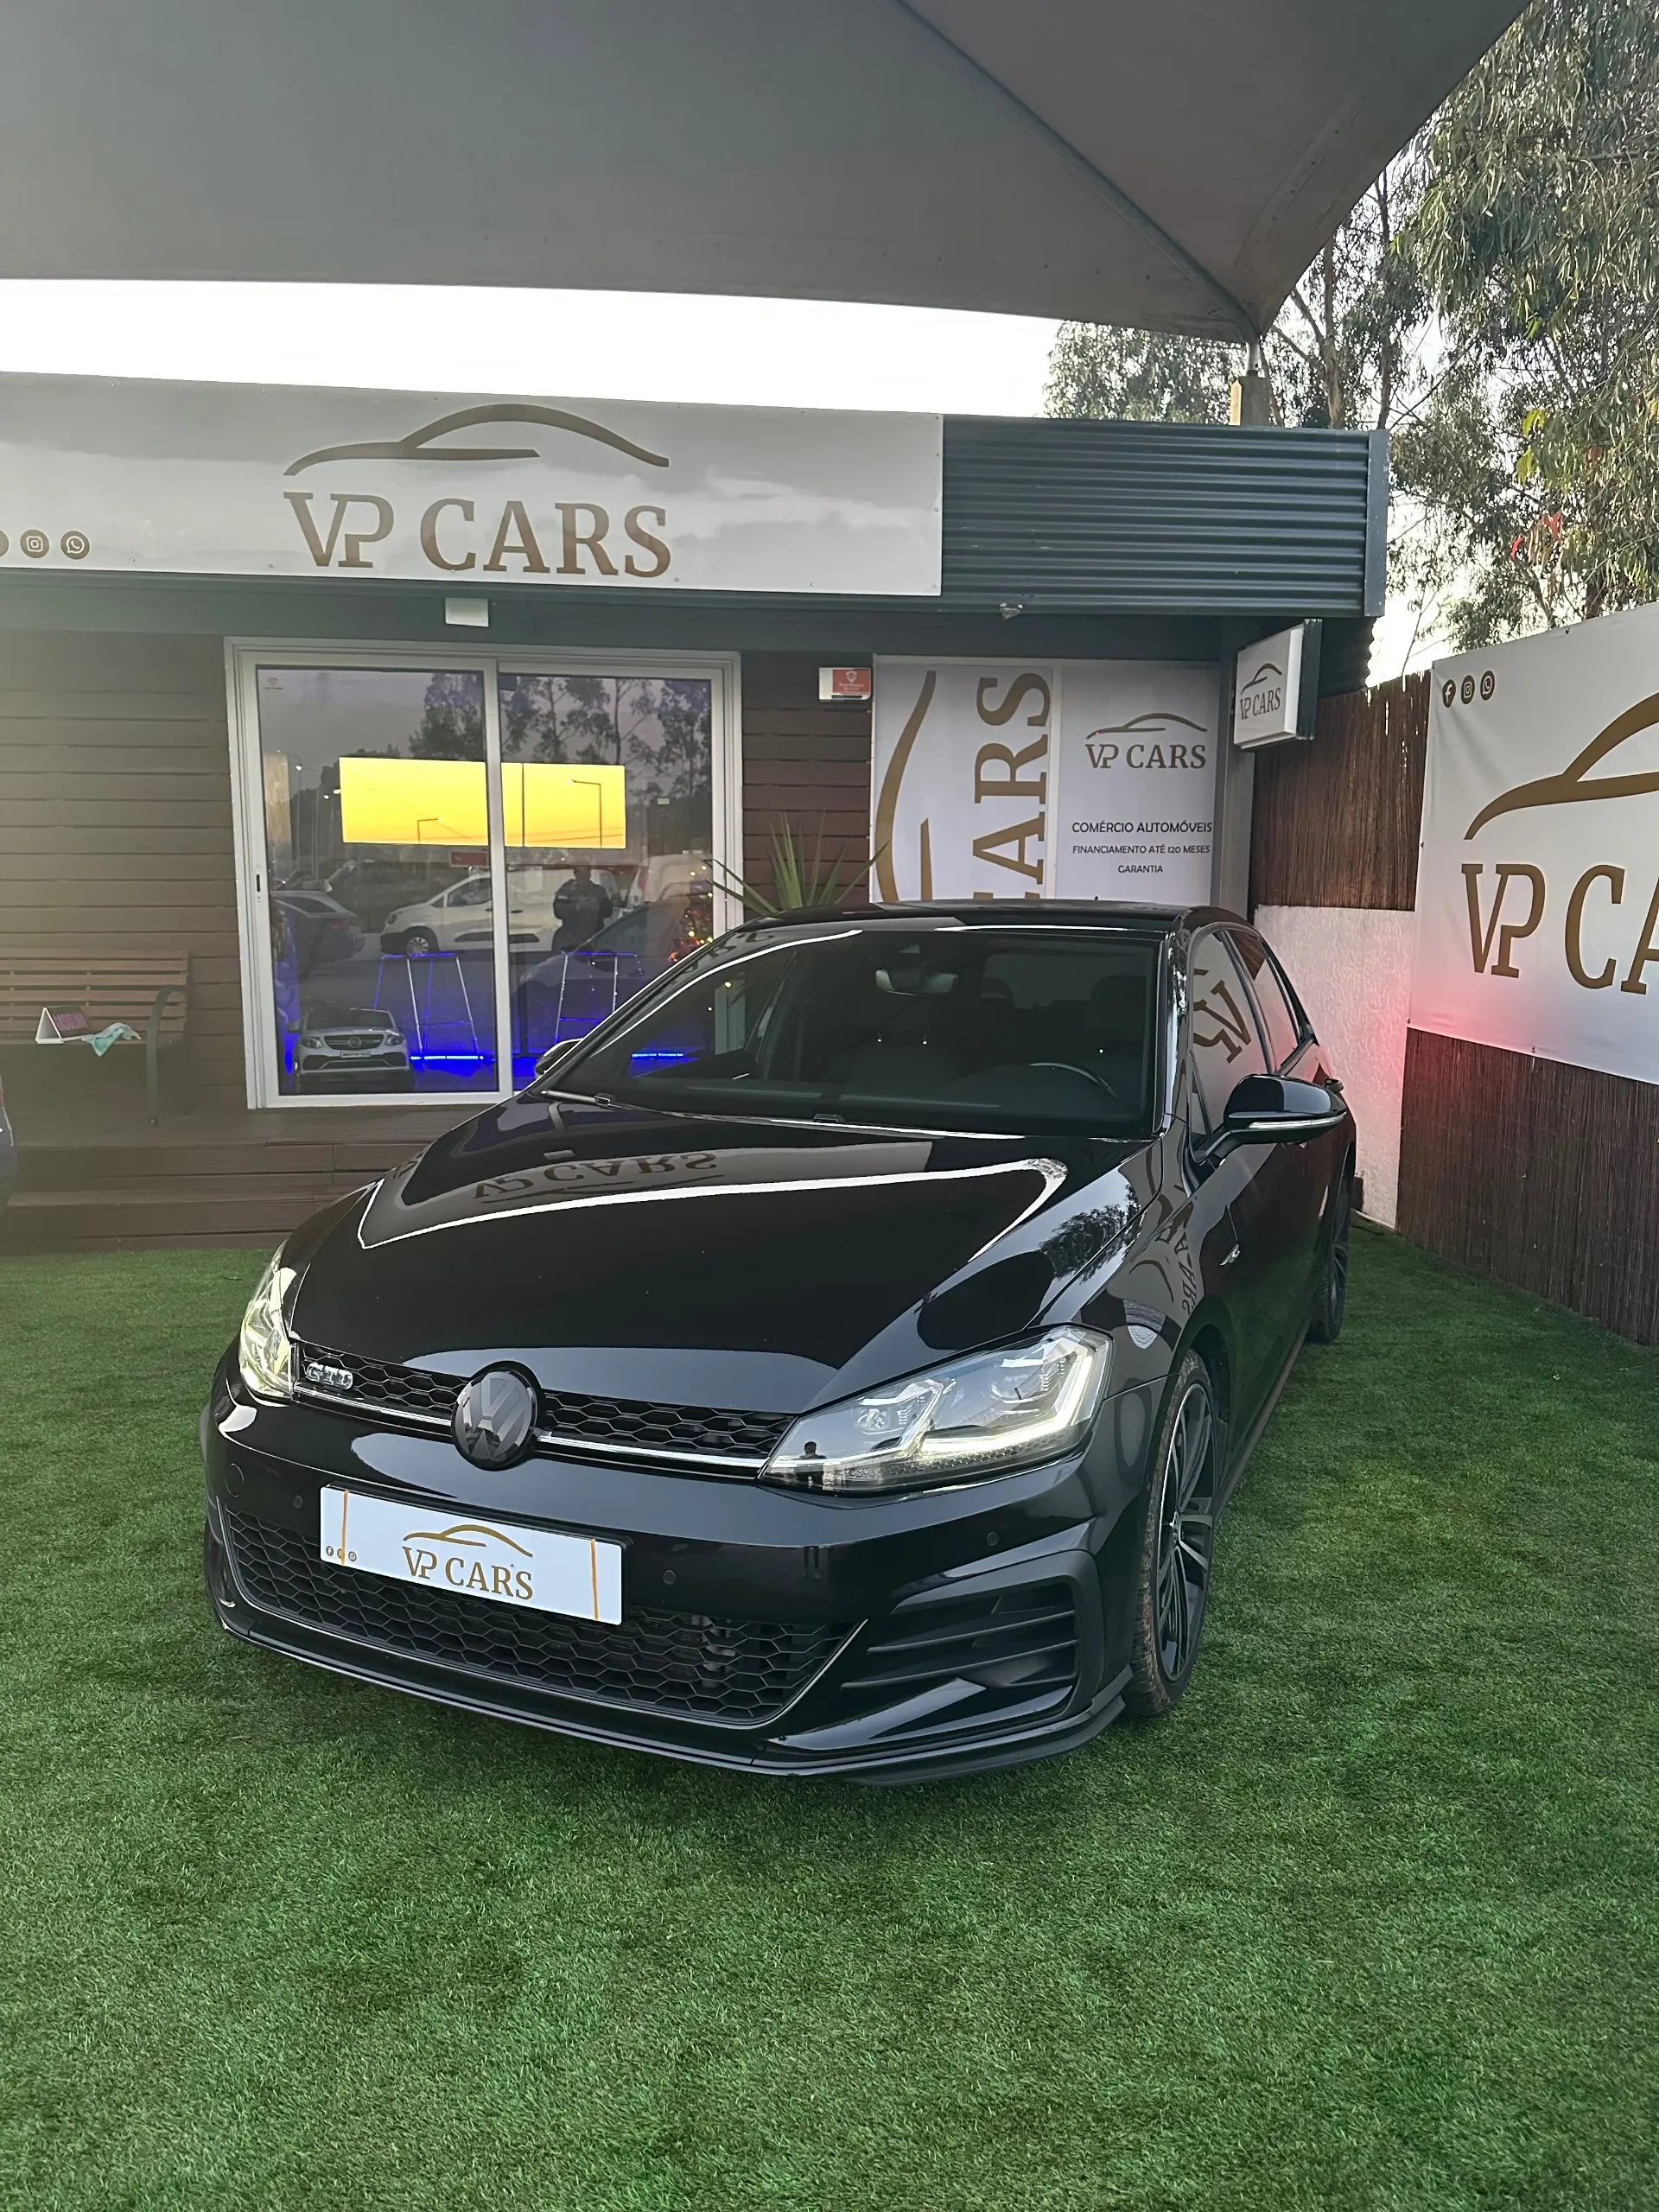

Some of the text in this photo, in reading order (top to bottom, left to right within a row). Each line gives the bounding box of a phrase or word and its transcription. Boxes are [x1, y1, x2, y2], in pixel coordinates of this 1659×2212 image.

[283, 492, 671, 578] VP CARS
[1240, 688, 1281, 720] VP CARS
[1085, 744, 1206, 769] VP CARS
[973, 672, 1051, 899] ARS
[1072, 820, 1212, 833] COMÉRCIO AUTOMÓVEIS
[1072, 845, 1147, 854] FINANCIAMENTO
[1148, 844, 1166, 854] ATÉ
[1182, 845, 1210, 854] MESES
[1461, 863, 1546, 978] VP
[402, 1546, 534, 1600] VP CARS
